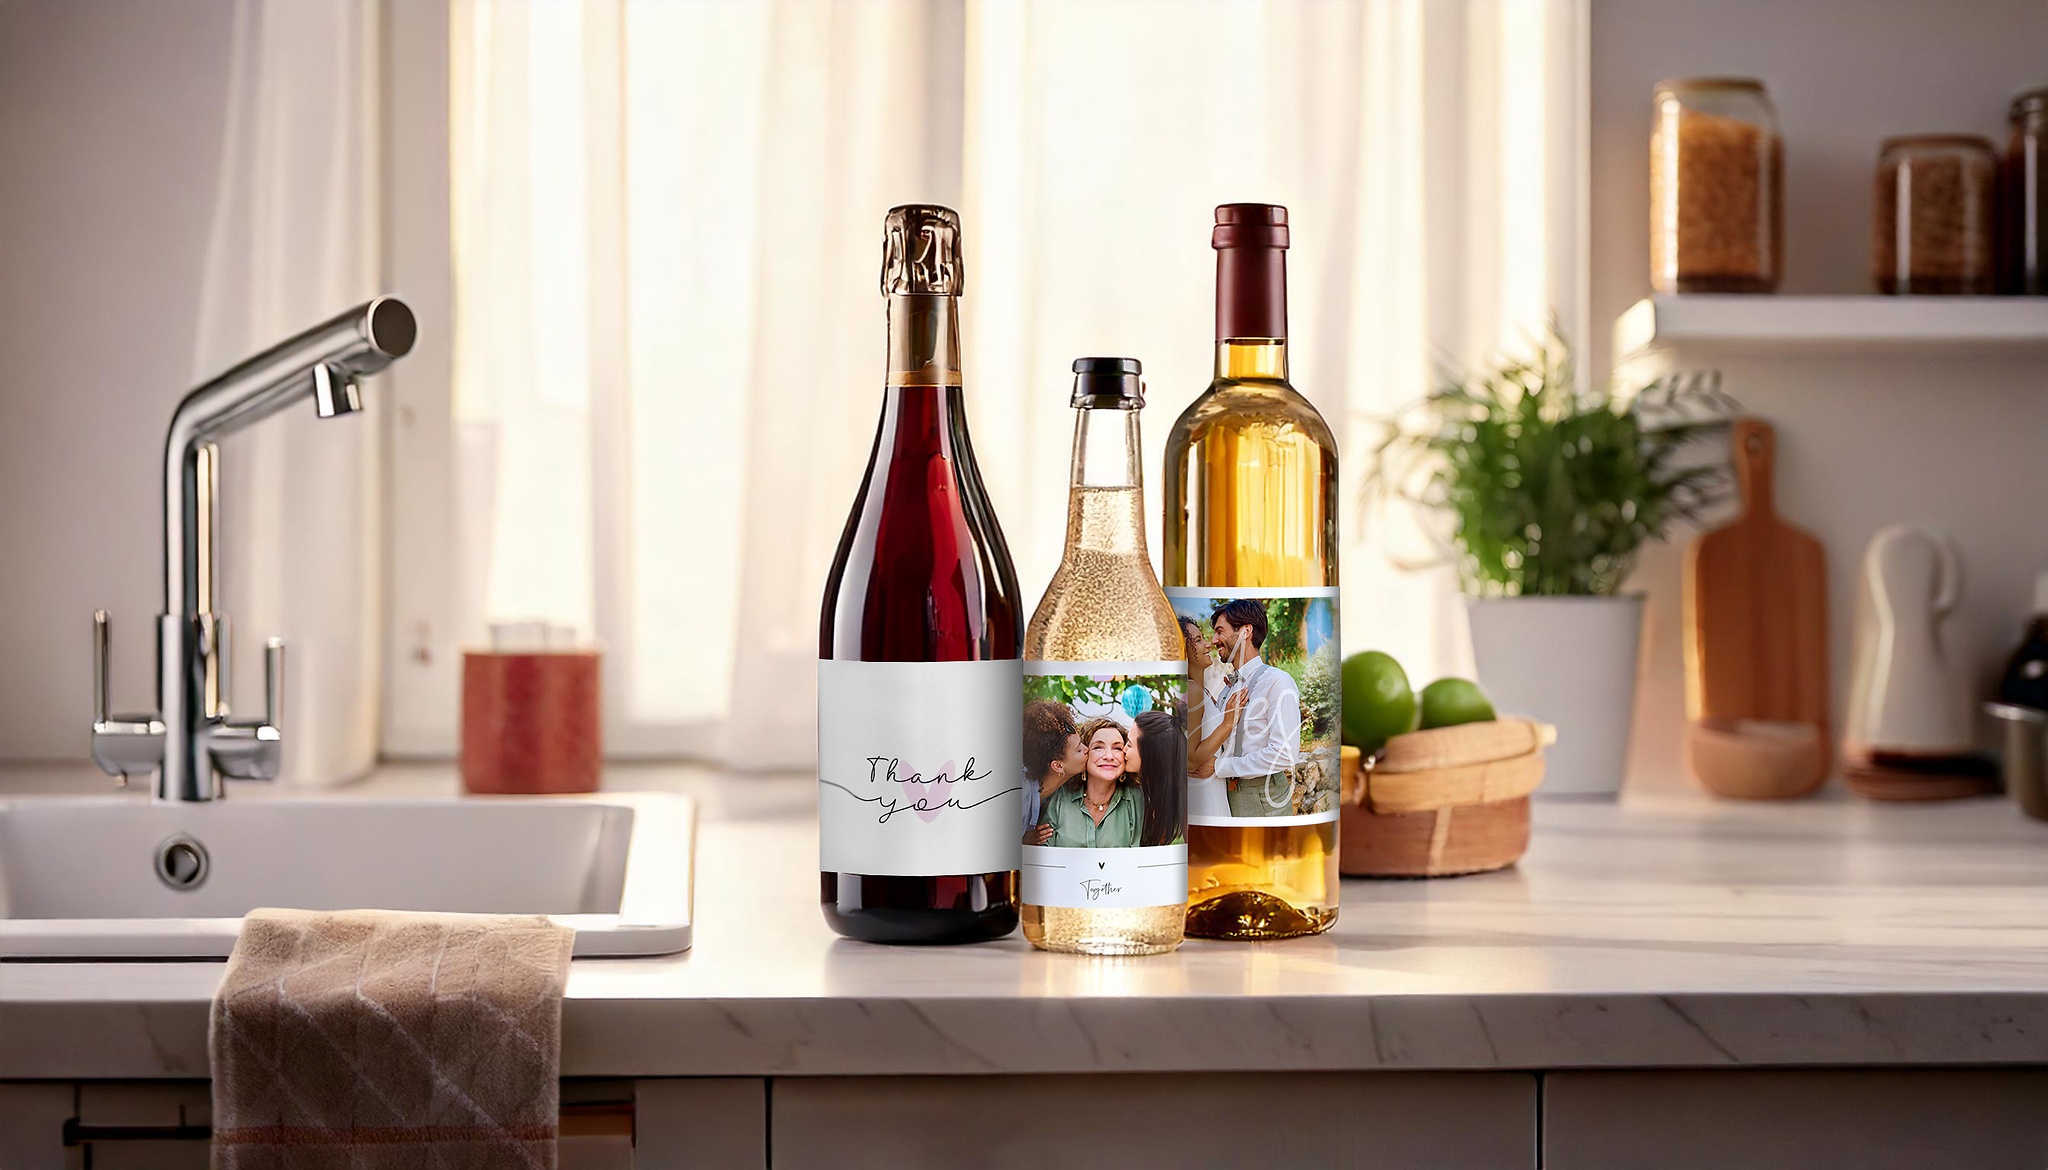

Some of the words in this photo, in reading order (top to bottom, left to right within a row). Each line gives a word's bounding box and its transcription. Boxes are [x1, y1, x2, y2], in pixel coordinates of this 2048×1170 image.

[866, 755, 993, 784] Thank
[862, 796, 986, 824] you
[1079, 878, 1122, 901] Together
